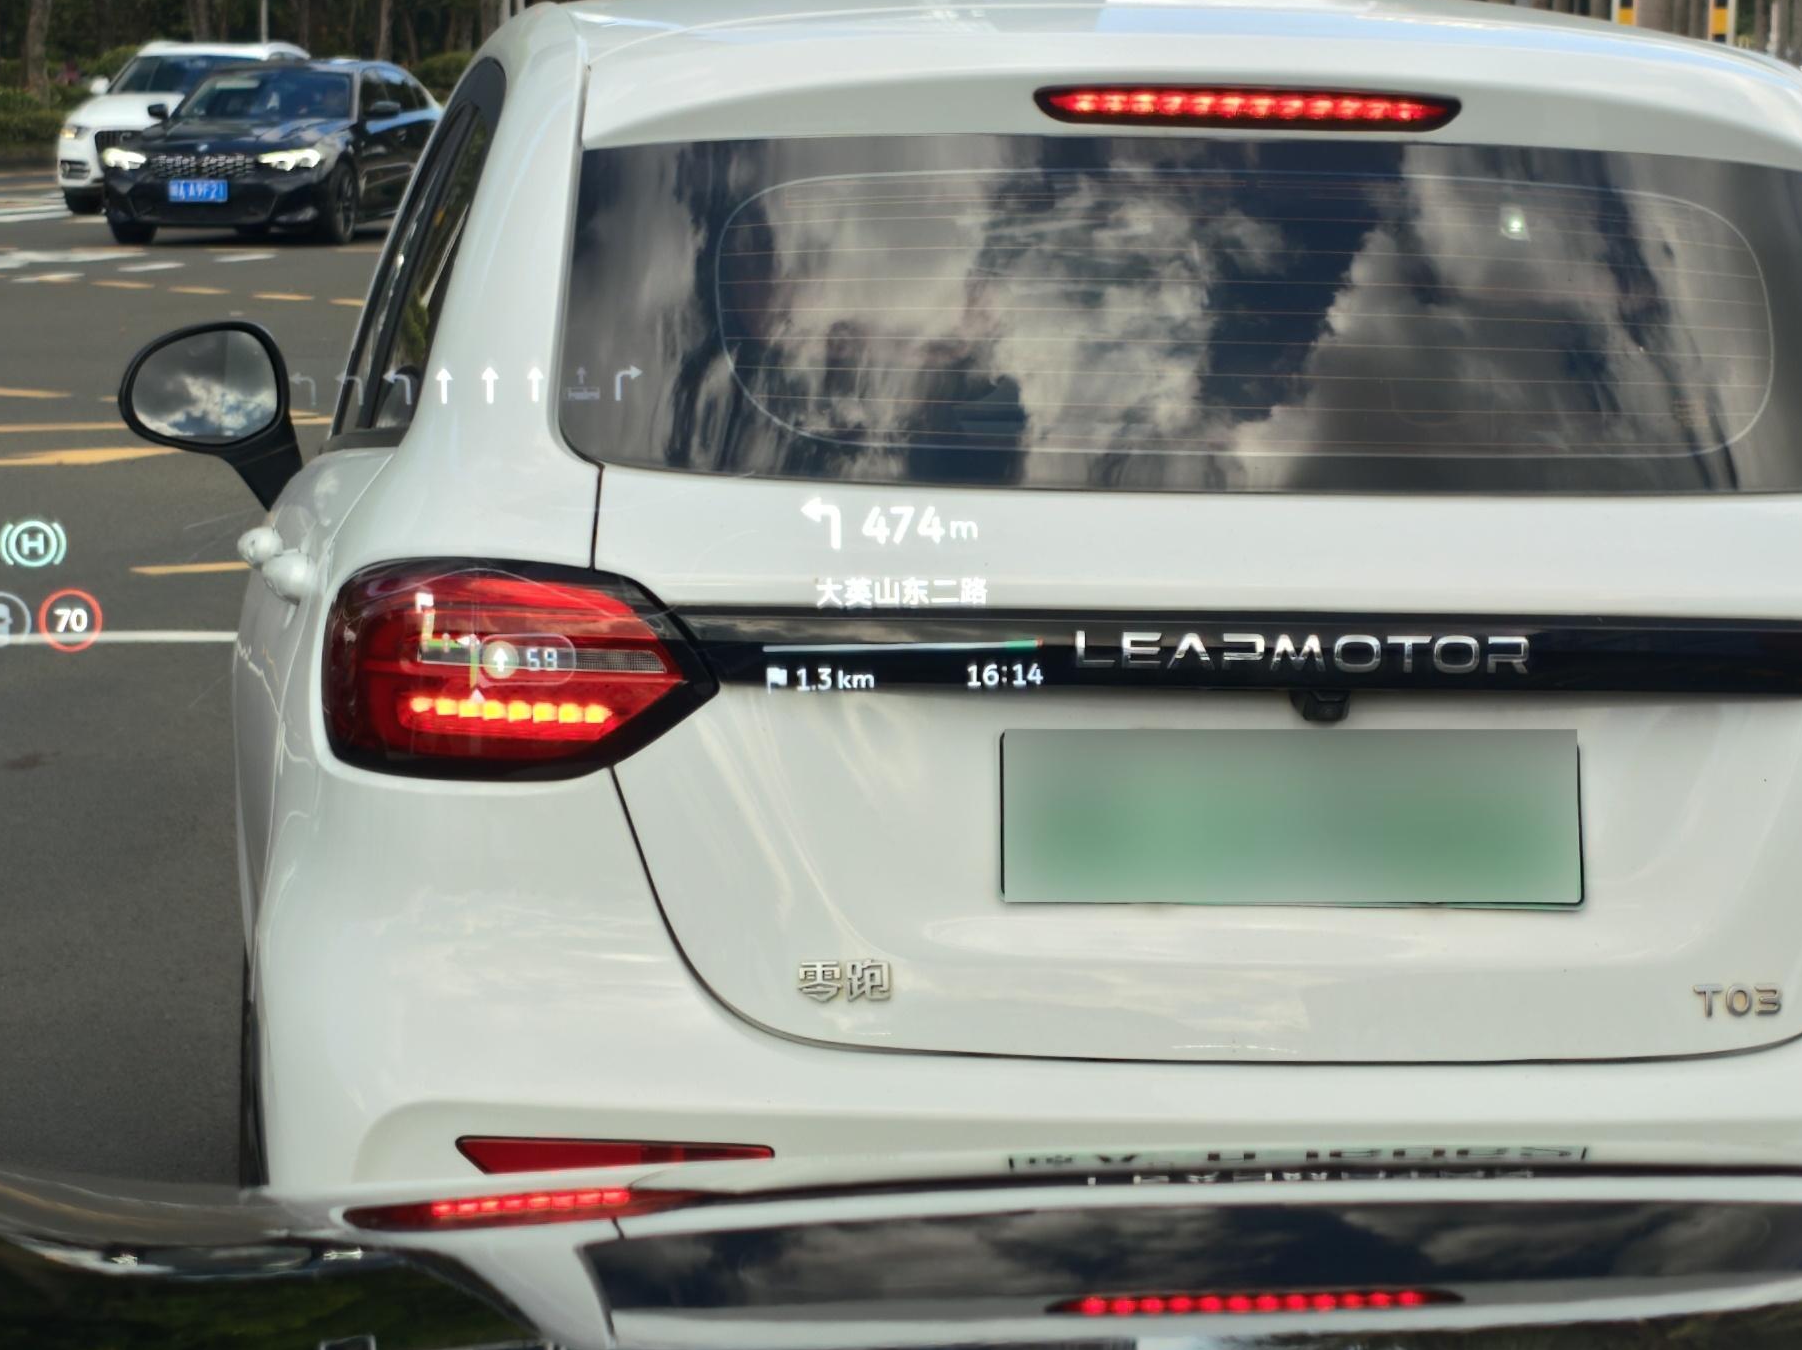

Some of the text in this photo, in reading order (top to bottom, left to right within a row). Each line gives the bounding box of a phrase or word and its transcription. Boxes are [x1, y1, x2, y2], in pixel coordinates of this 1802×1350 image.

[815, 577, 988, 608] 大英山东二路
[53, 608, 88, 633] 70
[1075, 630, 1530, 674] LEAPMOTOR
[967, 662, 1044, 687] 16:14
[798, 959, 891, 1003] 零跑
